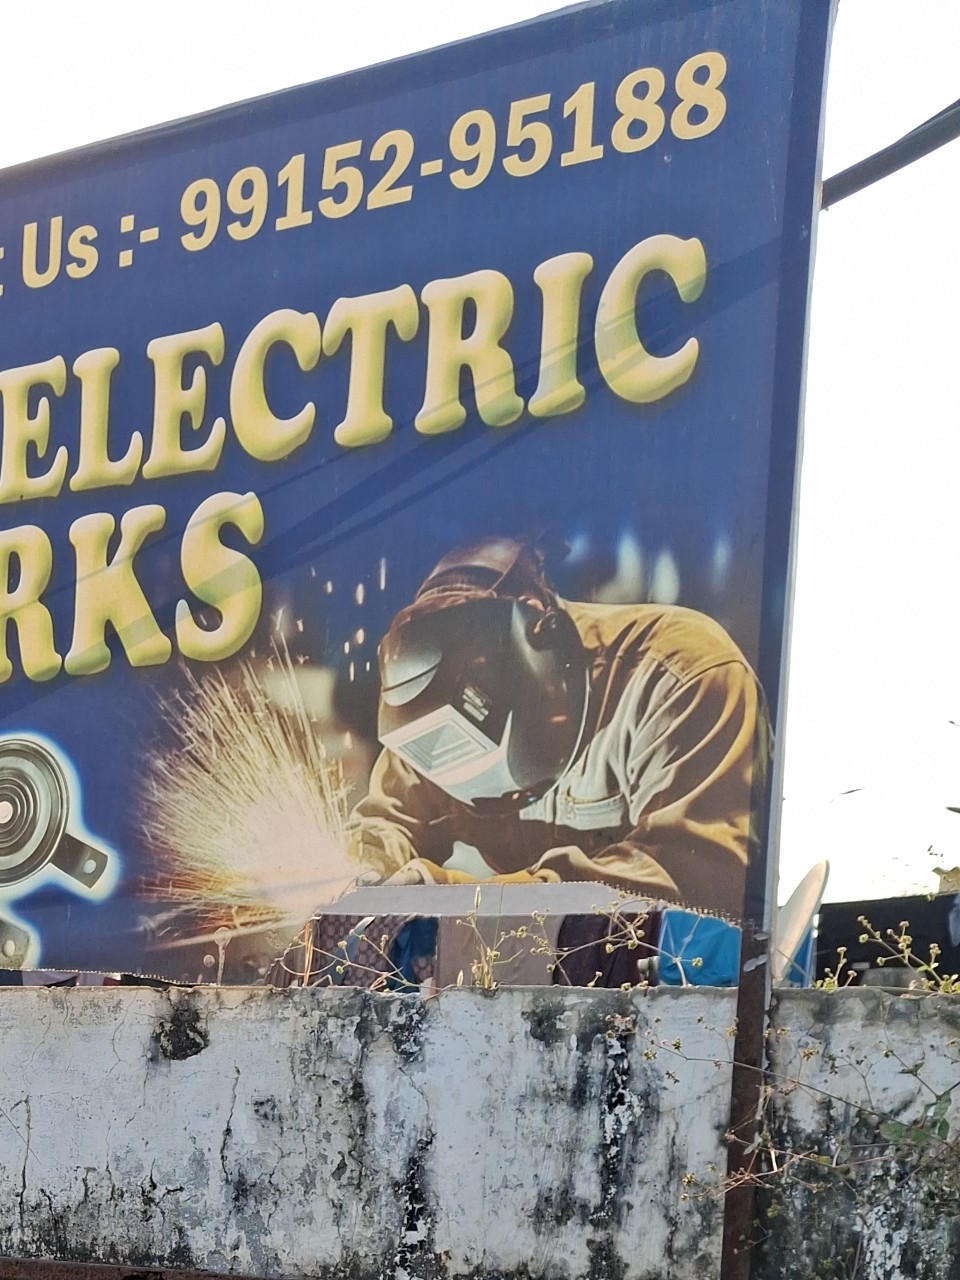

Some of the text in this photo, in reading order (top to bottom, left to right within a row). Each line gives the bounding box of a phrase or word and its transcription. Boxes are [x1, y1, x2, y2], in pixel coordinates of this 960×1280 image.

[23, 214, 98, 288] Us
[119, 215, 160, 267] :-
[180, 50, 727, 252] 99152-95188
